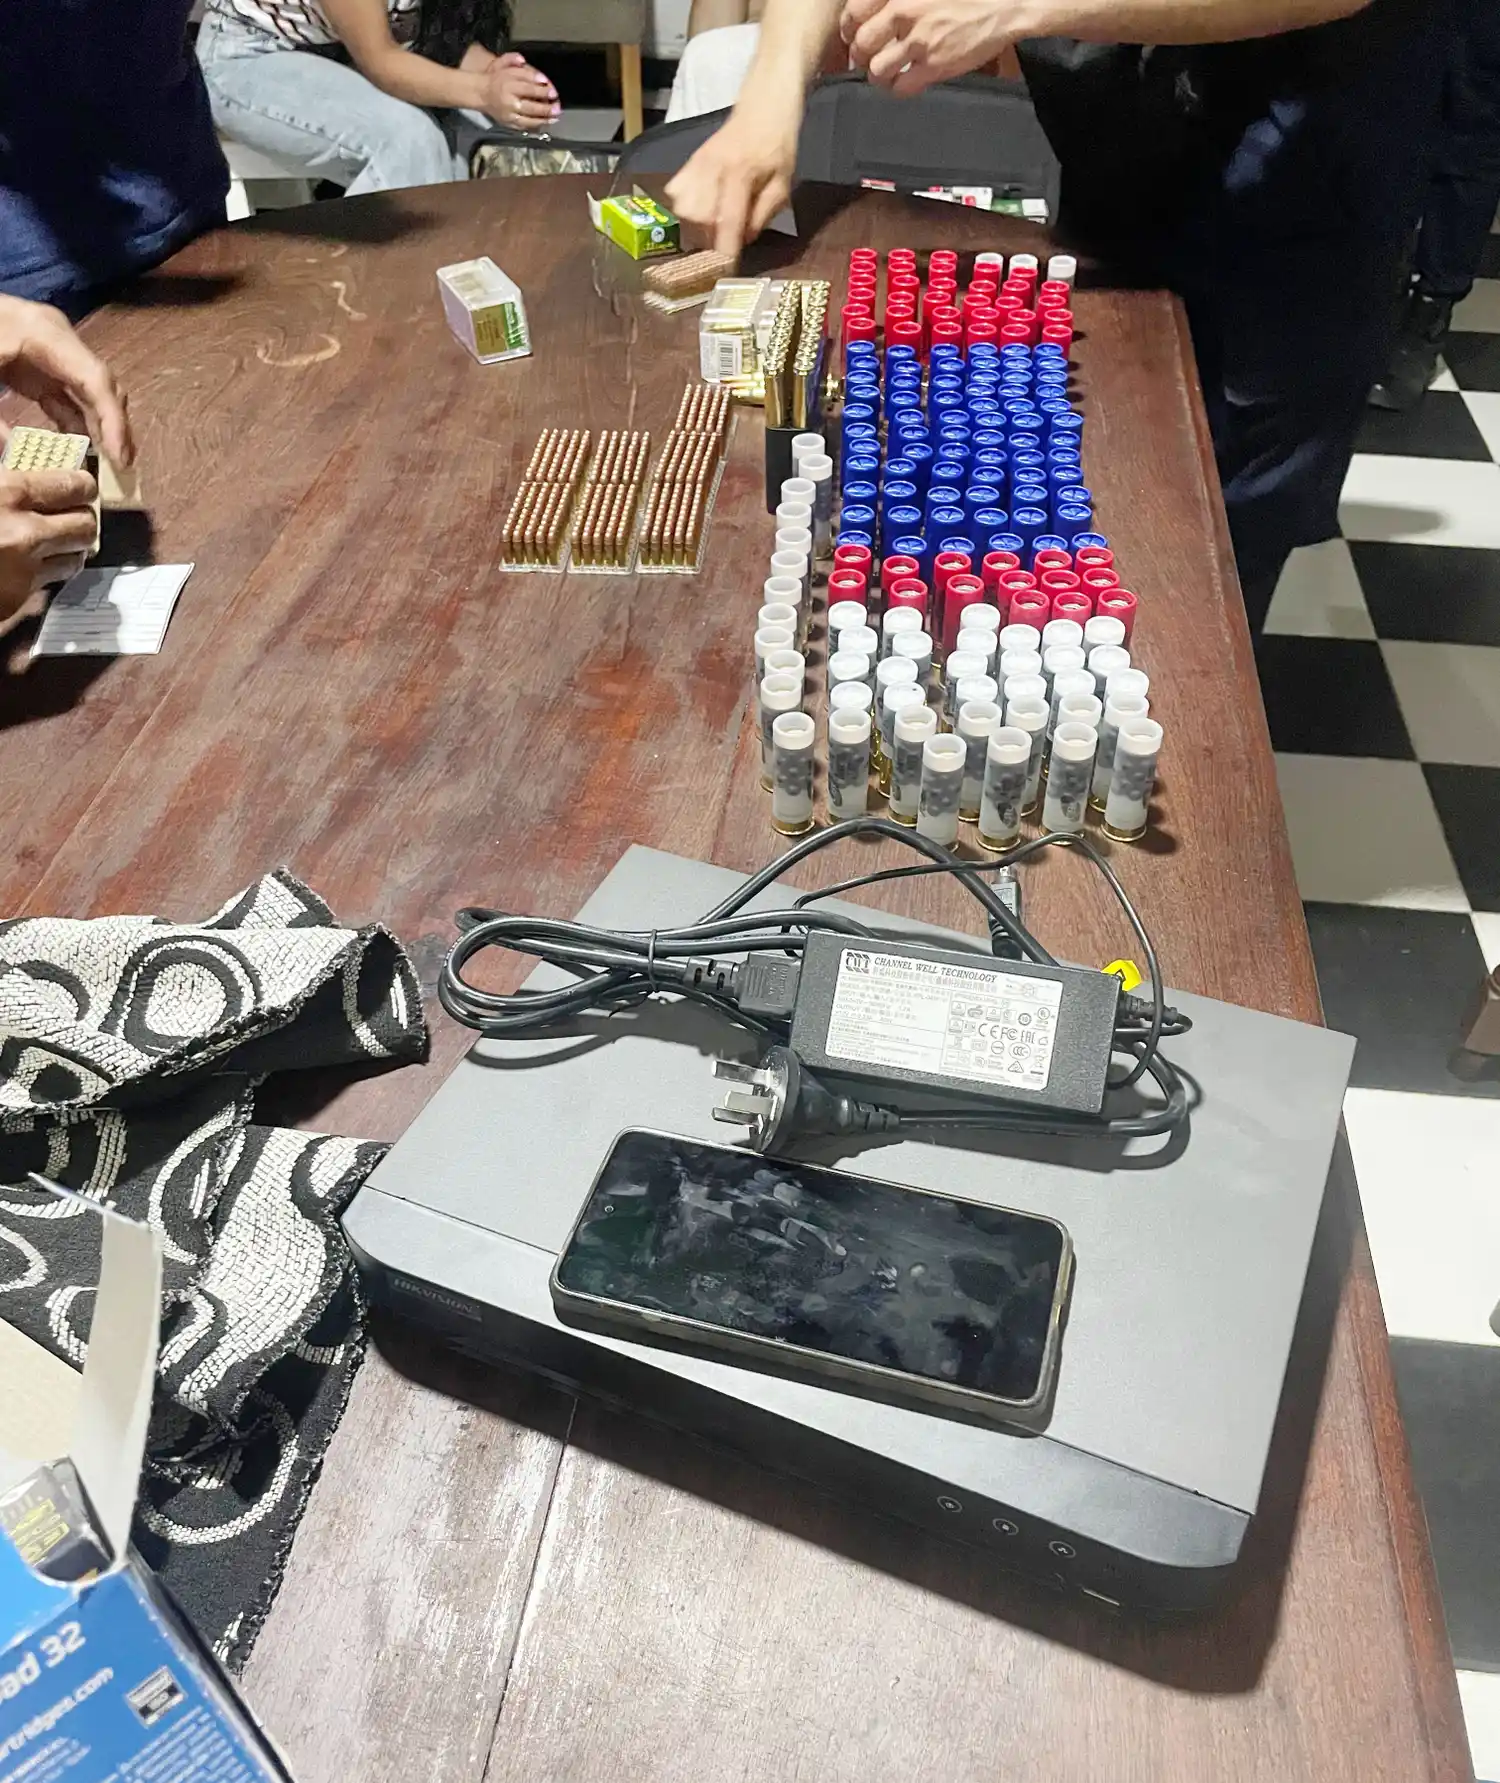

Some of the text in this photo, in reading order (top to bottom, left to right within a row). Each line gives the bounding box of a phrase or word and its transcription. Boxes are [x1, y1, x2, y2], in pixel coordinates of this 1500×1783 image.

[874, 956, 913, 971] CHANNEL
[915, 963, 939, 974] WELL
[941, 967, 998, 983] TECHNOLOGY
[393, 1278, 473, 1313] HIKVISION
[0, 1620, 87, 1705] ad 32
